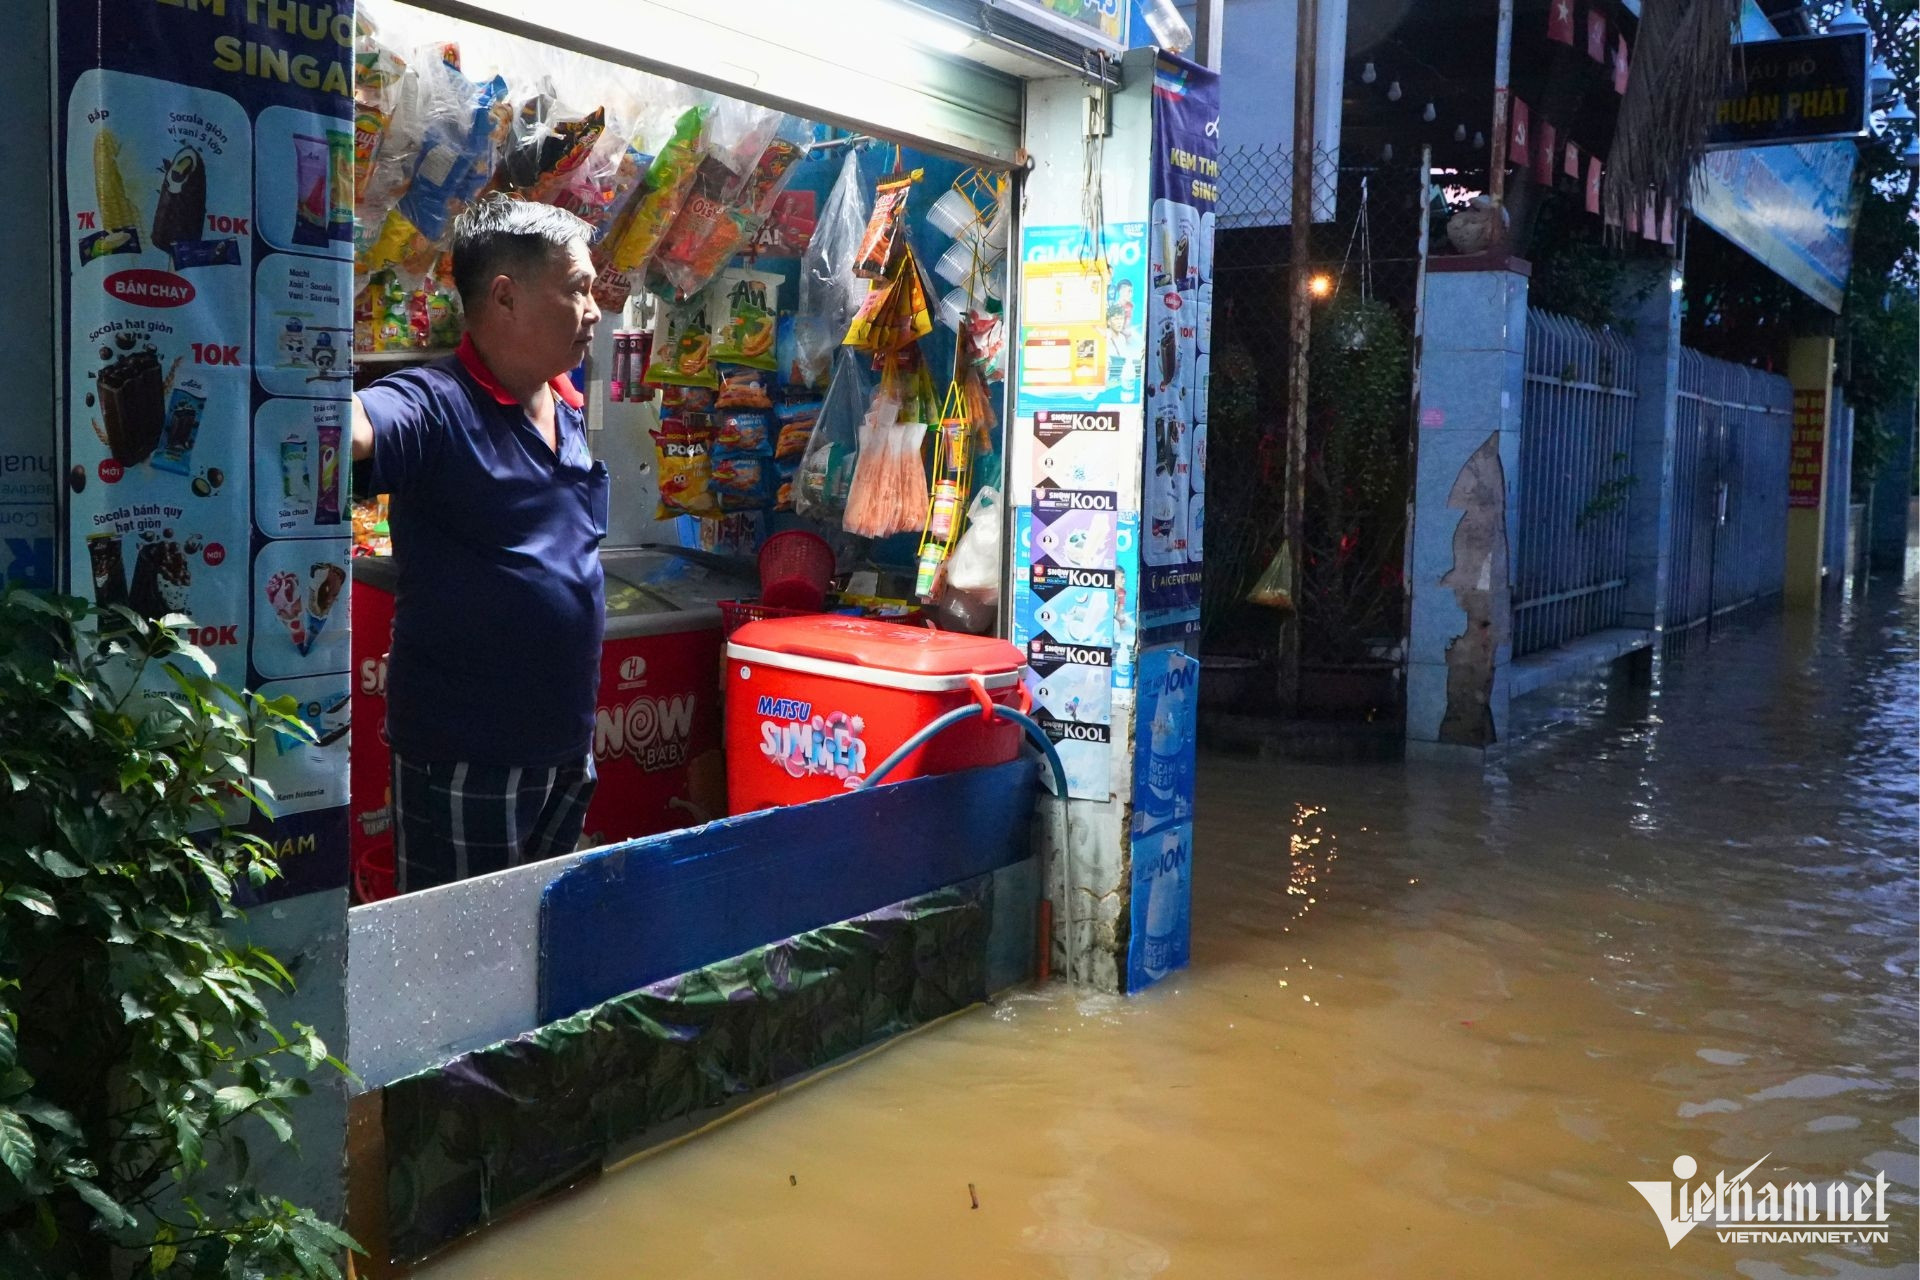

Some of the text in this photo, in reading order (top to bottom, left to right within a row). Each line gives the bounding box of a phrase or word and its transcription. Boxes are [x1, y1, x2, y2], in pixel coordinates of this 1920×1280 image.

[1171, 147, 1196, 171] KEM
[78, 212, 95, 230] 7K
[207, 214, 249, 236] 10K
[90, 322, 123, 343] Socola
[191, 343, 241, 367] 10K
[1073, 414, 1116, 431] KOOL
[1071, 493, 1113, 511] KOOL
[93, 503, 184, 526] Socola bánh quy
[1069, 569, 1112, 588] KOOL
[186, 625, 239, 648] 10K
[1066, 646, 1109, 666] KOOL
[757, 695, 812, 722] MATSU
[595, 693, 696, 758] NOW
[1064, 723, 1106, 742] KOOL
[646, 744, 690, 765] BABY
[760, 720, 867, 775] SUMMER
